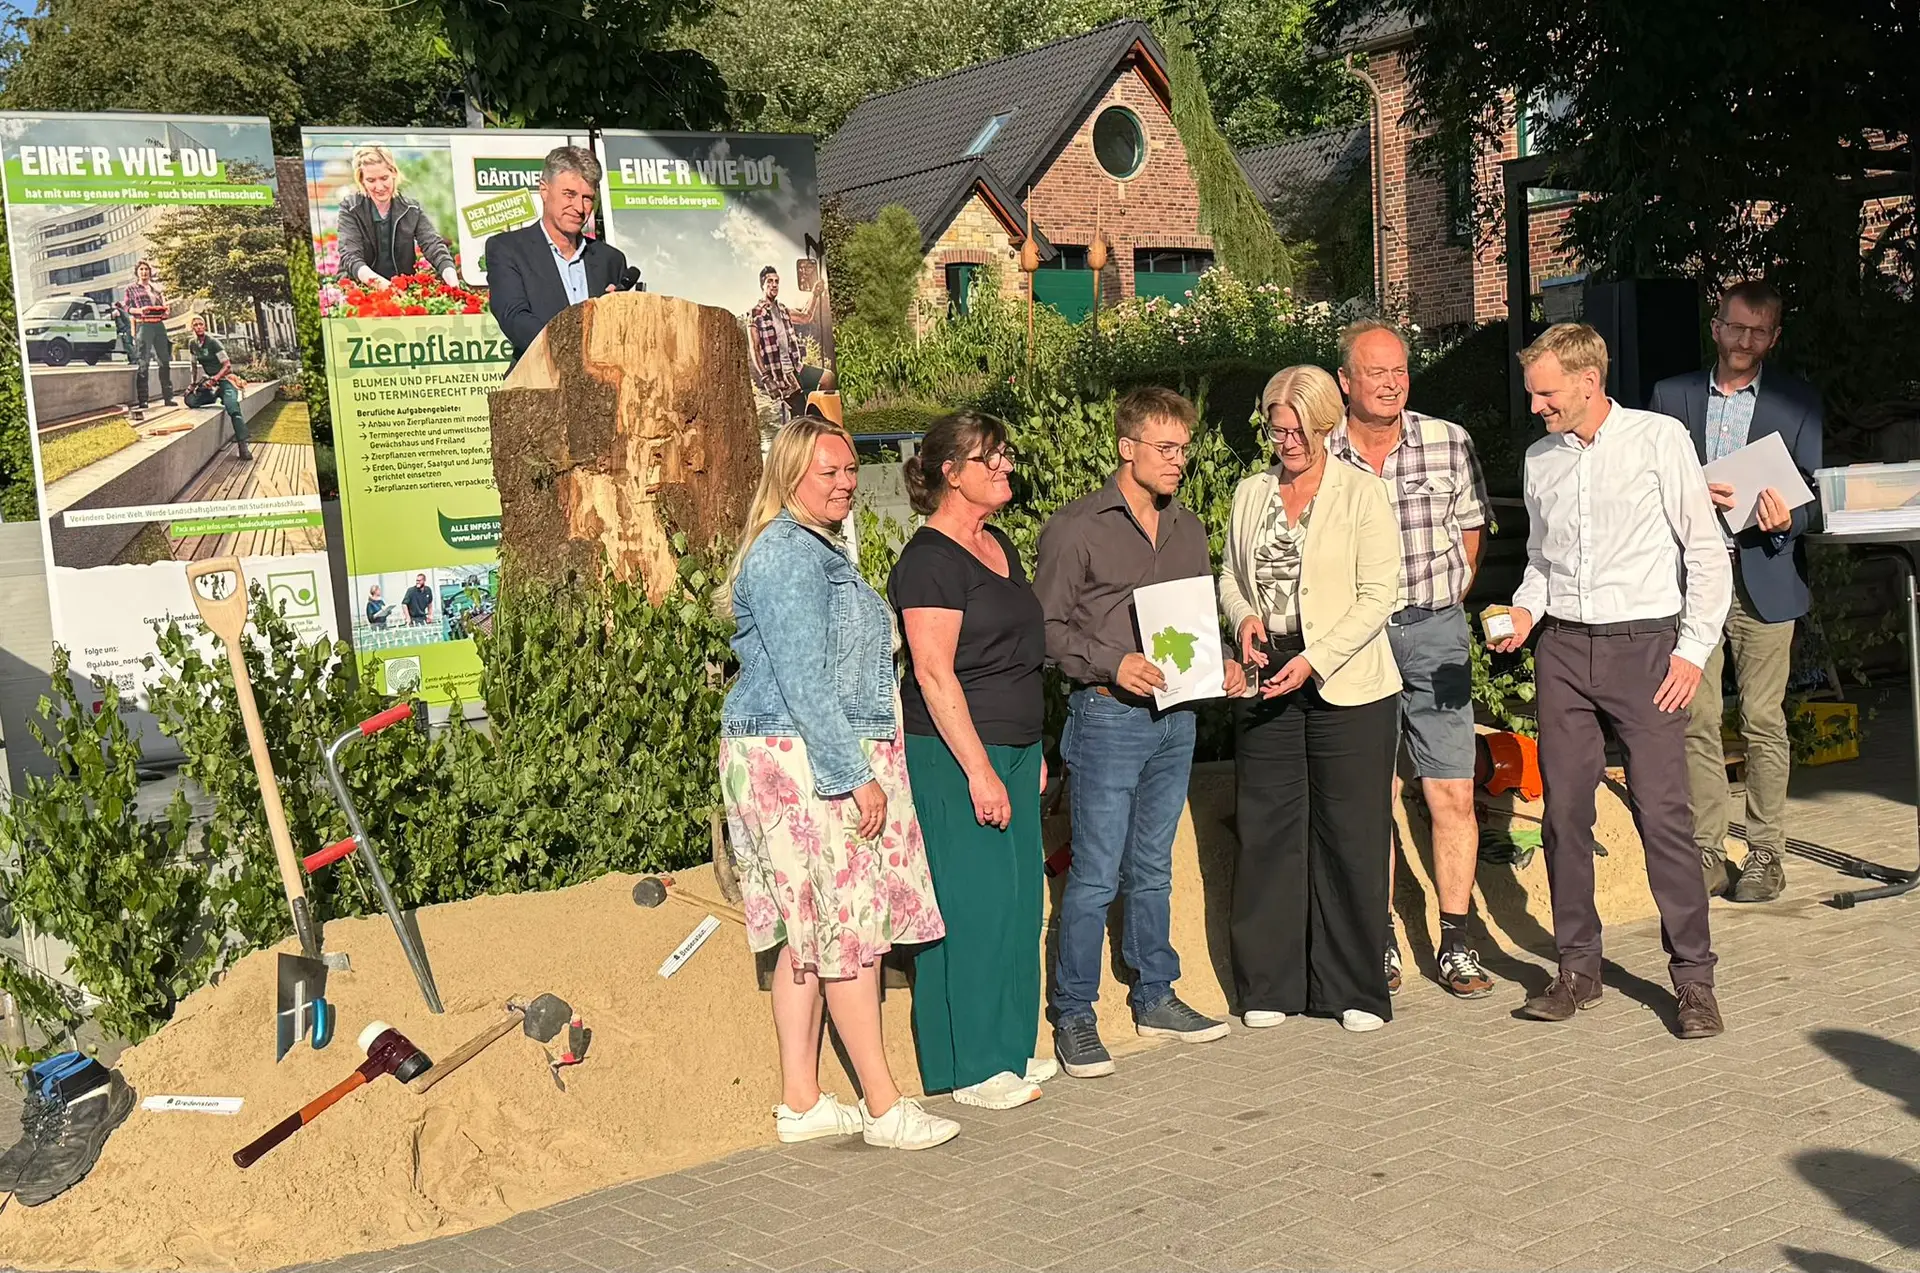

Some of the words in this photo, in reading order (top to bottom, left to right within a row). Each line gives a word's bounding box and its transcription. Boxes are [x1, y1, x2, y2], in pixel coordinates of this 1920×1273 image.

[118, 146, 174, 176] WIE
[180, 148, 218, 177] DU
[478, 168, 542, 186] GÄRTNE
[696, 159, 737, 186] WIE
[744, 160, 773, 186] DU
[25, 188, 42, 198] hat
[44, 188, 62, 198] mit
[64, 190, 82, 198] uns
[84, 190, 120, 201] genaue
[122, 188, 150, 199] Pläne
[158, 188, 180, 199] auch
[182, 188, 206, 200] beim
[208, 189, 266, 200] Klimaschutz.
[467, 206, 486, 221] DER
[488, 195, 528, 214] ZUKUNFT
[625, 195, 646, 204] kann
[648, 195, 678, 204] Großes
[680, 195, 720, 208] bewegen.
[353, 378, 397, 388] BLUMEN
[400, 376, 422, 386] UND
[426, 374, 479, 384] PFLANZEN
[354, 392, 376, 401] UND
[380, 388, 466, 400] TERMINGERECHT
[470, 386, 500, 396] PROD
[357, 408, 395, 417] Berufliche
[396, 406, 461, 416] Aufgabengebiete:
[407, 417, 452, 426] Zierpflanzen
[369, 430, 426, 440] Termingerechte
[370, 440, 419, 449] Gewächshaus
[421, 438, 434, 446] und
[436, 436, 465, 444] Freiland
[371, 452, 416, 461] Zierpflanzen
[418, 448, 459, 457] vermehren,
[372, 464, 396, 472] Erden,
[398, 462, 426, 470] Dünger,
[428, 460, 454, 469] Saatgut
[456, 458, 470, 466] und
[373, 474, 406, 483] gerichtet
[407, 470, 442, 478] einsetzen
[374, 484, 418, 493] Zierpflanzen
[454, 478, 490, 487] verpacken
[106, 512, 126, 520] Deine
[450, 524, 468, 532] ALLE
[470, 522, 491, 531] INFOS
[84, 647, 102, 656] Folge
